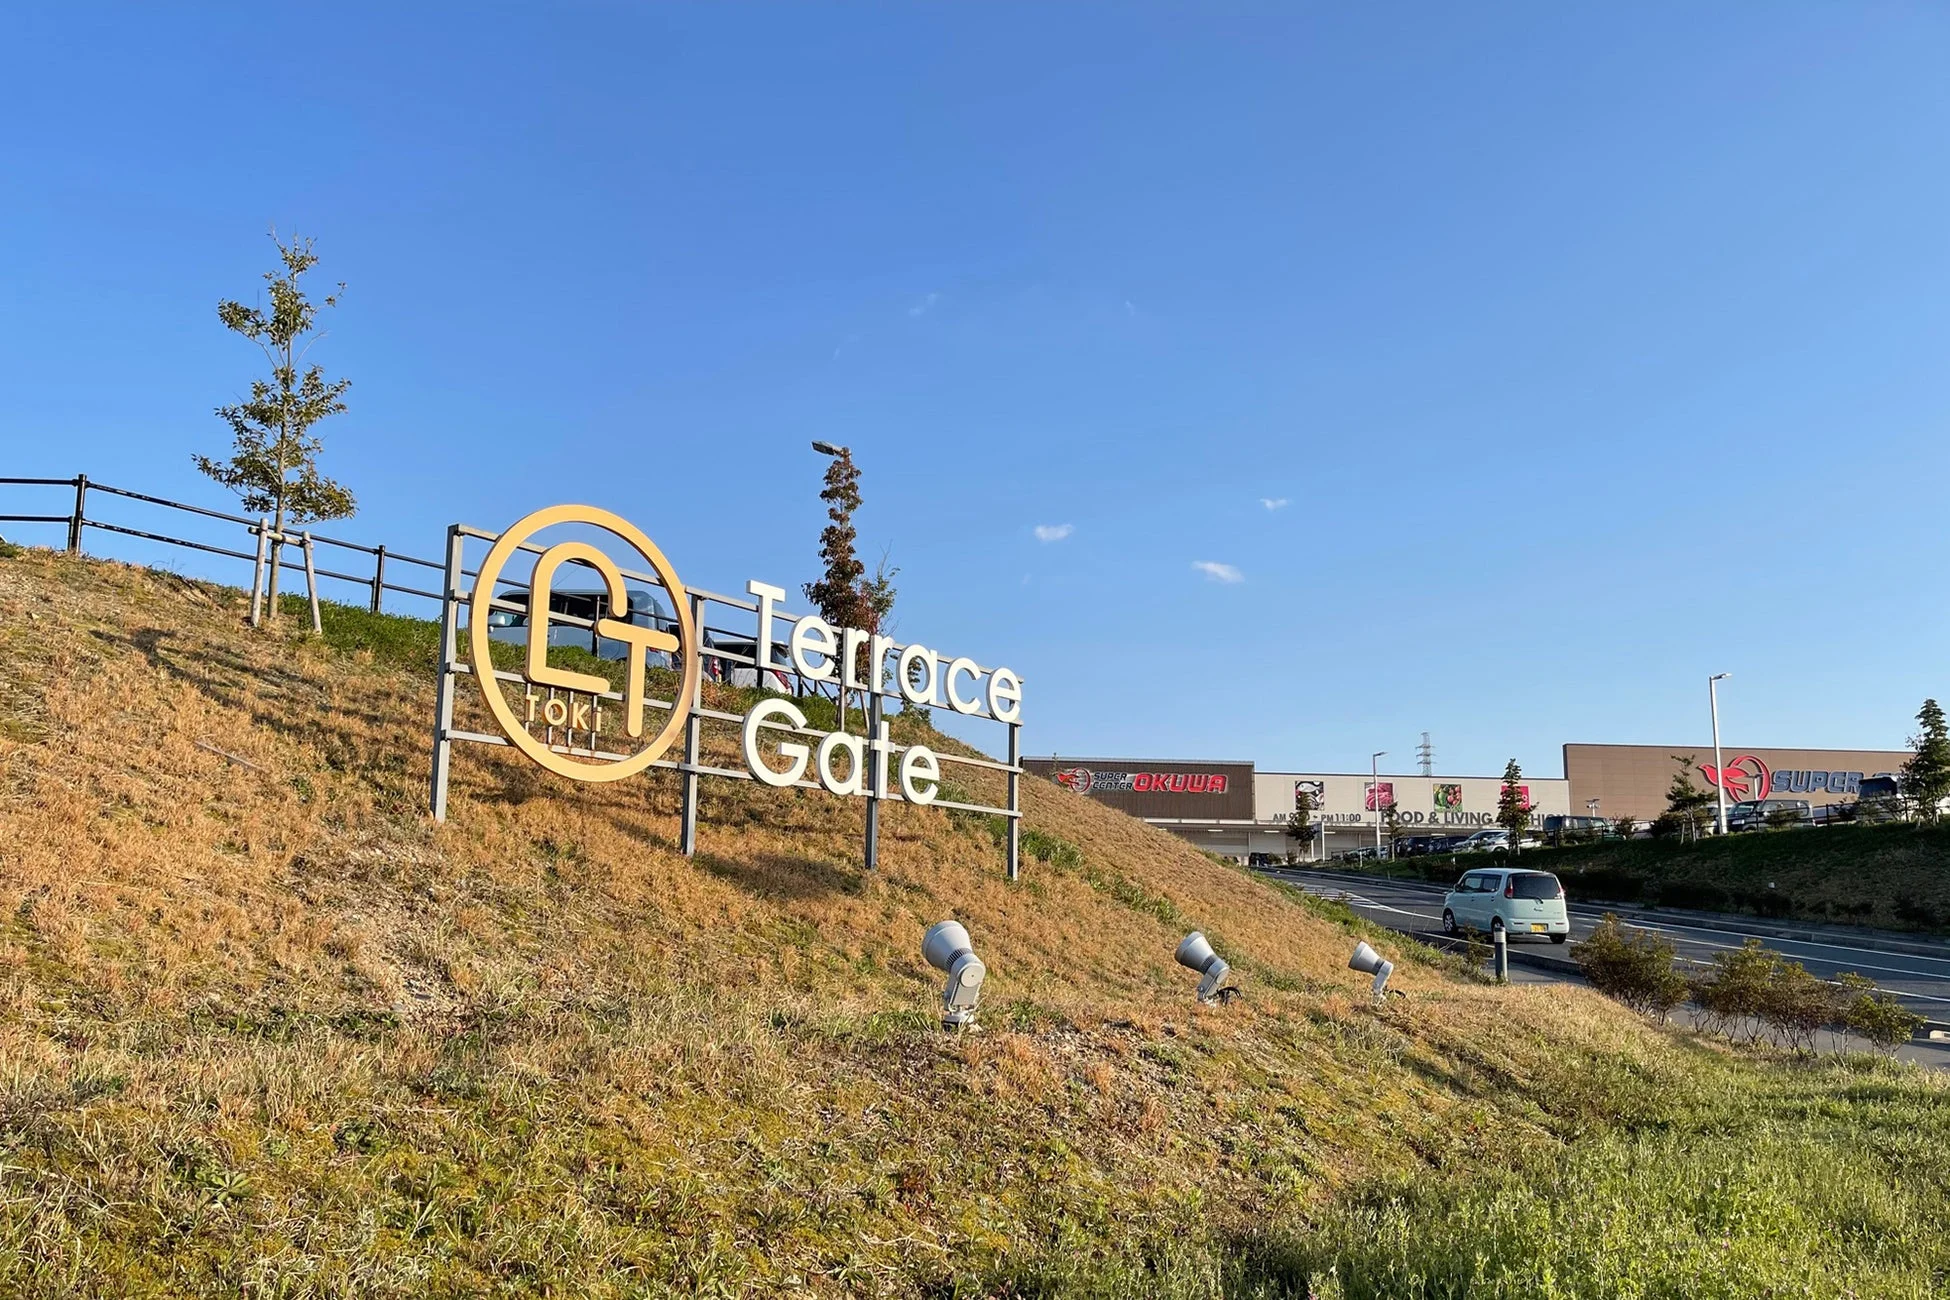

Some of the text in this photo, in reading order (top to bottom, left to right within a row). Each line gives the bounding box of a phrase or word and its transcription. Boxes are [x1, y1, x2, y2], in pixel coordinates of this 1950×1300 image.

[746, 581, 1022, 722] Terrace
[742, 699, 940, 805] Gate
[1092, 782, 1132, 790] CENTER
[1094, 772, 1128, 781] SUPER
[1133, 773, 1228, 793] OKUWA
[1772, 771, 1864, 793] SUPER
[1428, 811, 1439, 824] &
[1444, 812, 1493, 825] LIVING
